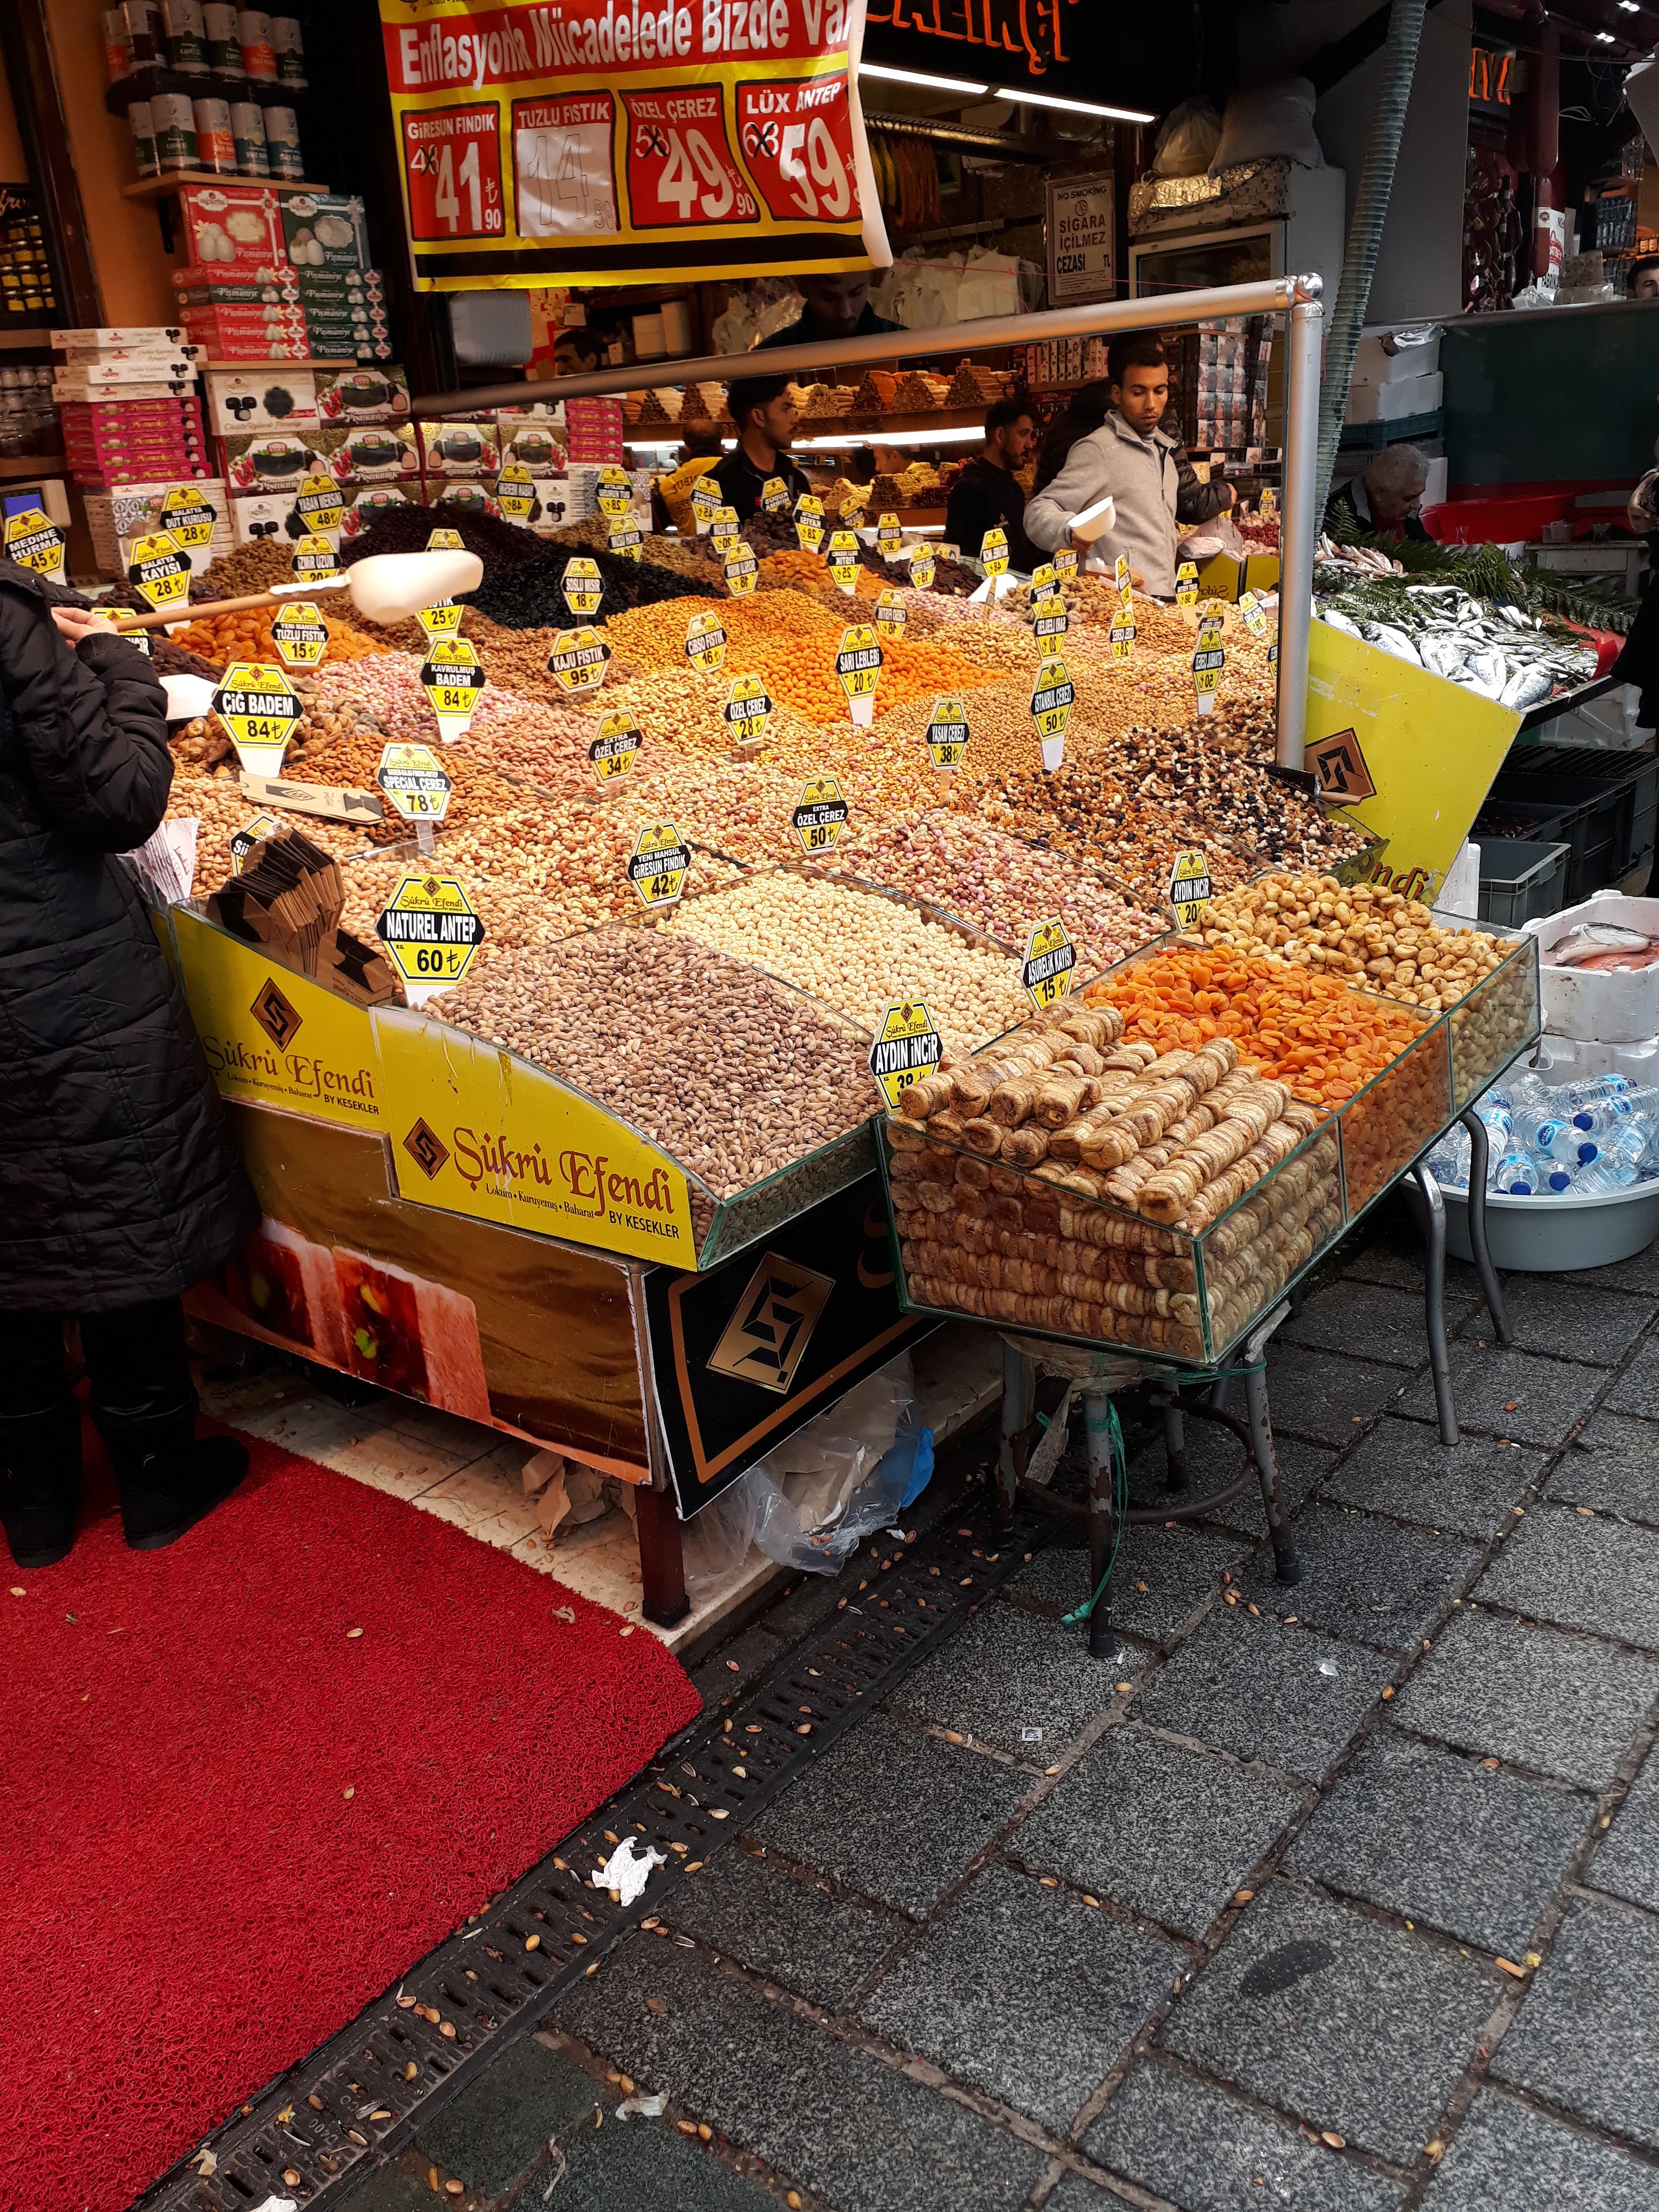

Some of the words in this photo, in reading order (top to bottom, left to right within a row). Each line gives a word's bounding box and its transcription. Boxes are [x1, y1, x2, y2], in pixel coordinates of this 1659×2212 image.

[528, 0, 692, 69] Mücadelede
[745, 90, 790, 115] LÜX
[795, 81, 842, 113] ANTEP
[518, 107, 560, 129] TUZLU
[564, 102, 610, 123] FISTIK
[630, 98, 665, 119] ÖZEL
[667, 98, 718, 124] ÇEREZ
[455, 114, 497, 135] FINDIK
[656, 128, 734, 219] 49
[779, 117, 852, 217] 59
[435, 141, 483, 233] 41
[1057, 192, 1070, 201] NO
[736, 193, 756, 215] 90
[484, 208, 502, 230] 90
[1057, 253, 1086, 275] CEZASI
[1103, 253, 1111, 268] TL
[165, 517, 182, 529] DUT
[11, 536, 62, 561] HURMA
[141, 562, 182, 583] KAYISI
[275, 630, 302, 641] TUZLU
[302, 631, 326, 642] FISTIK
[706, 630, 725, 648] FISTIK
[552, 654, 578, 670] KAJU
[577, 646, 606, 663] FISTIK
[839, 656, 855, 672] SARI
[431, 664, 476, 677] KAVRULMUŞ
[436, 674, 472, 687] BADEM
[249, 696, 294, 716] BADEM
[729, 703, 746, 721] ÖZEL
[746, 697, 766, 719] ÇEREZ
[594, 744, 614, 759] ÖZEL
[614, 737, 638, 756] ÇEREZ
[604, 734, 628, 745] EXTRA
[419, 776, 447, 792] ÇEREZ
[797, 813, 818, 826] ÖZEL
[819, 809, 845, 825] ÇEREZ
[812, 804, 829, 812] EXTRA
[663, 854, 686, 872] FINDIK
[1174, 880, 1193, 902] AYDIN
[386, 911, 439, 941] NATUREL
[439, 913, 477, 943] ANTEP
[1054, 945, 1072, 973] KAYISI
[876, 1039, 908, 1074] AYDIN
[285, 1054, 376, 1098] Efendi
[324, 1094, 335, 1105] BY
[337, 1097, 380, 1115] KESEKLER
[453, 1126, 553, 1192] Şükrü
[559, 1149, 675, 1217] Efendi
[485, 1183, 513, 1200] Lokum
[518, 1190, 558, 1214] Kuruyemiş
[563, 1201, 596, 1220] Baharat
[609, 1210, 623, 1227] BY
[625, 1215, 681, 1240] KESEKLER
